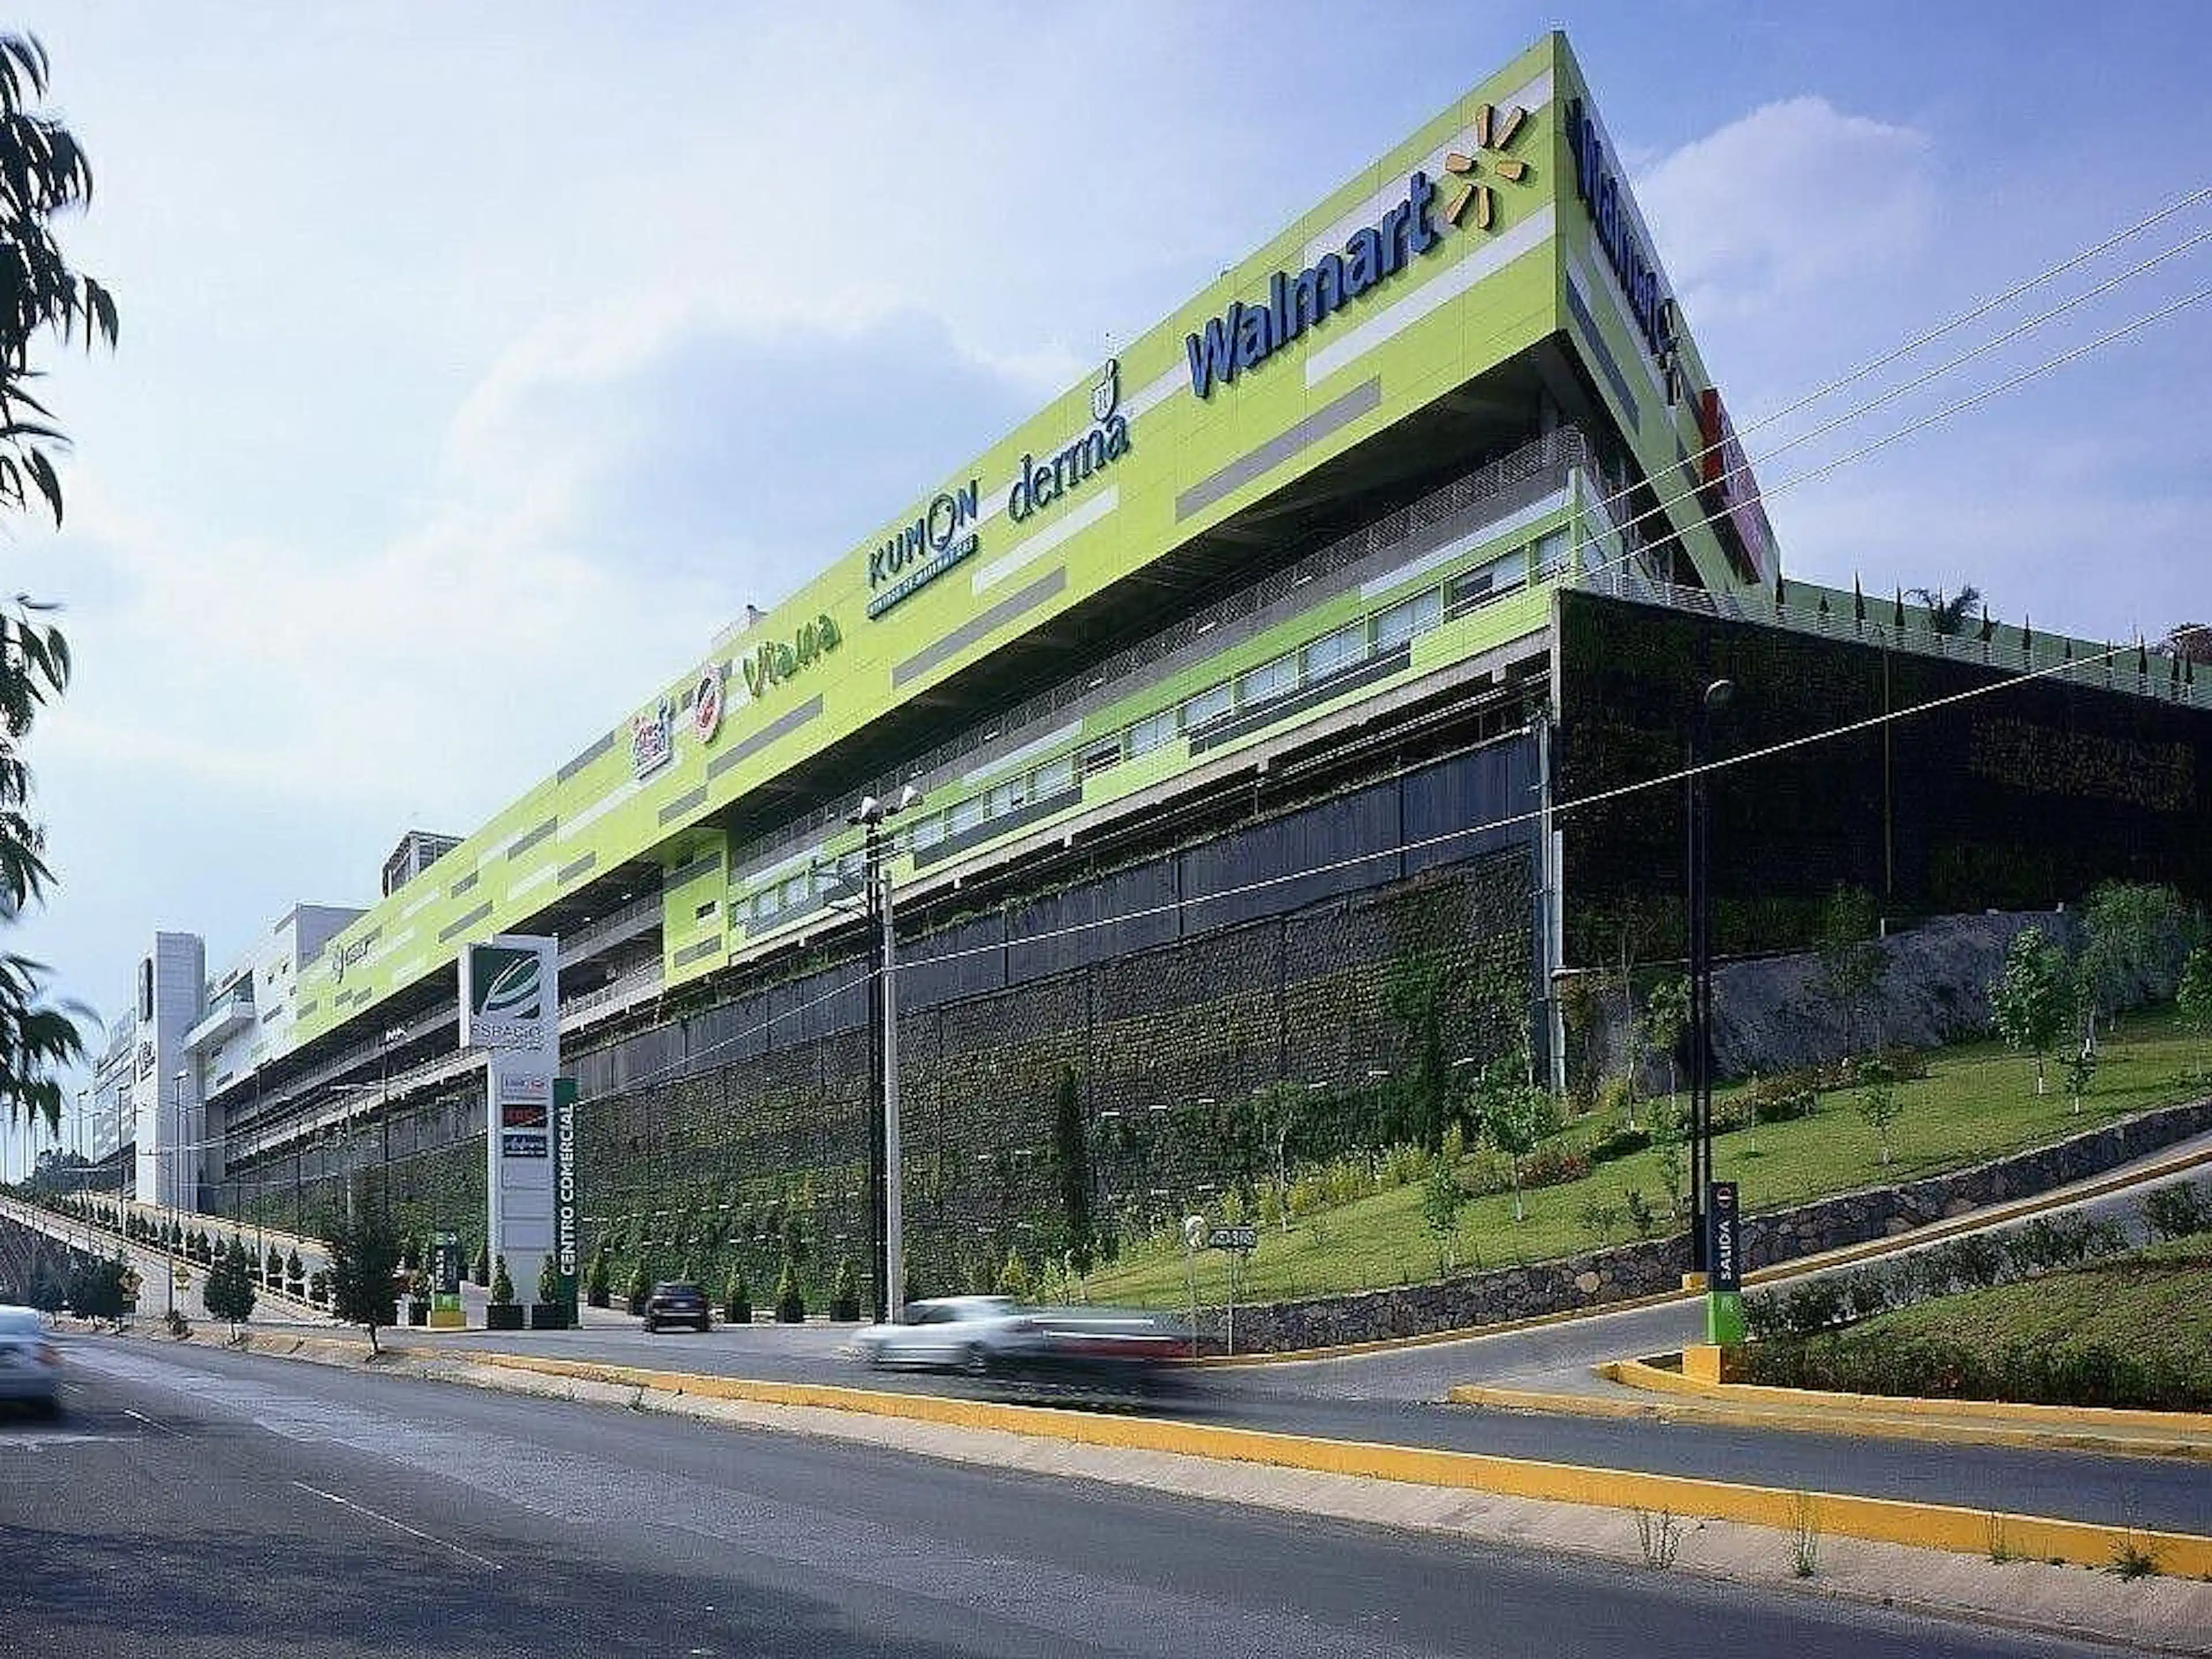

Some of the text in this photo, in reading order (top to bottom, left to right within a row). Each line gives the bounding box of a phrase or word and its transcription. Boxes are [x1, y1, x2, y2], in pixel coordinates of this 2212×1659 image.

[1185, 171, 1435, 399] Walmart
[1009, 415, 1130, 522] derma
[869, 478, 980, 589] KUMON
[560, 1103, 575, 1277] CENTRO COMERCIAL
[1718, 1219, 1732, 1281] SALIDA
